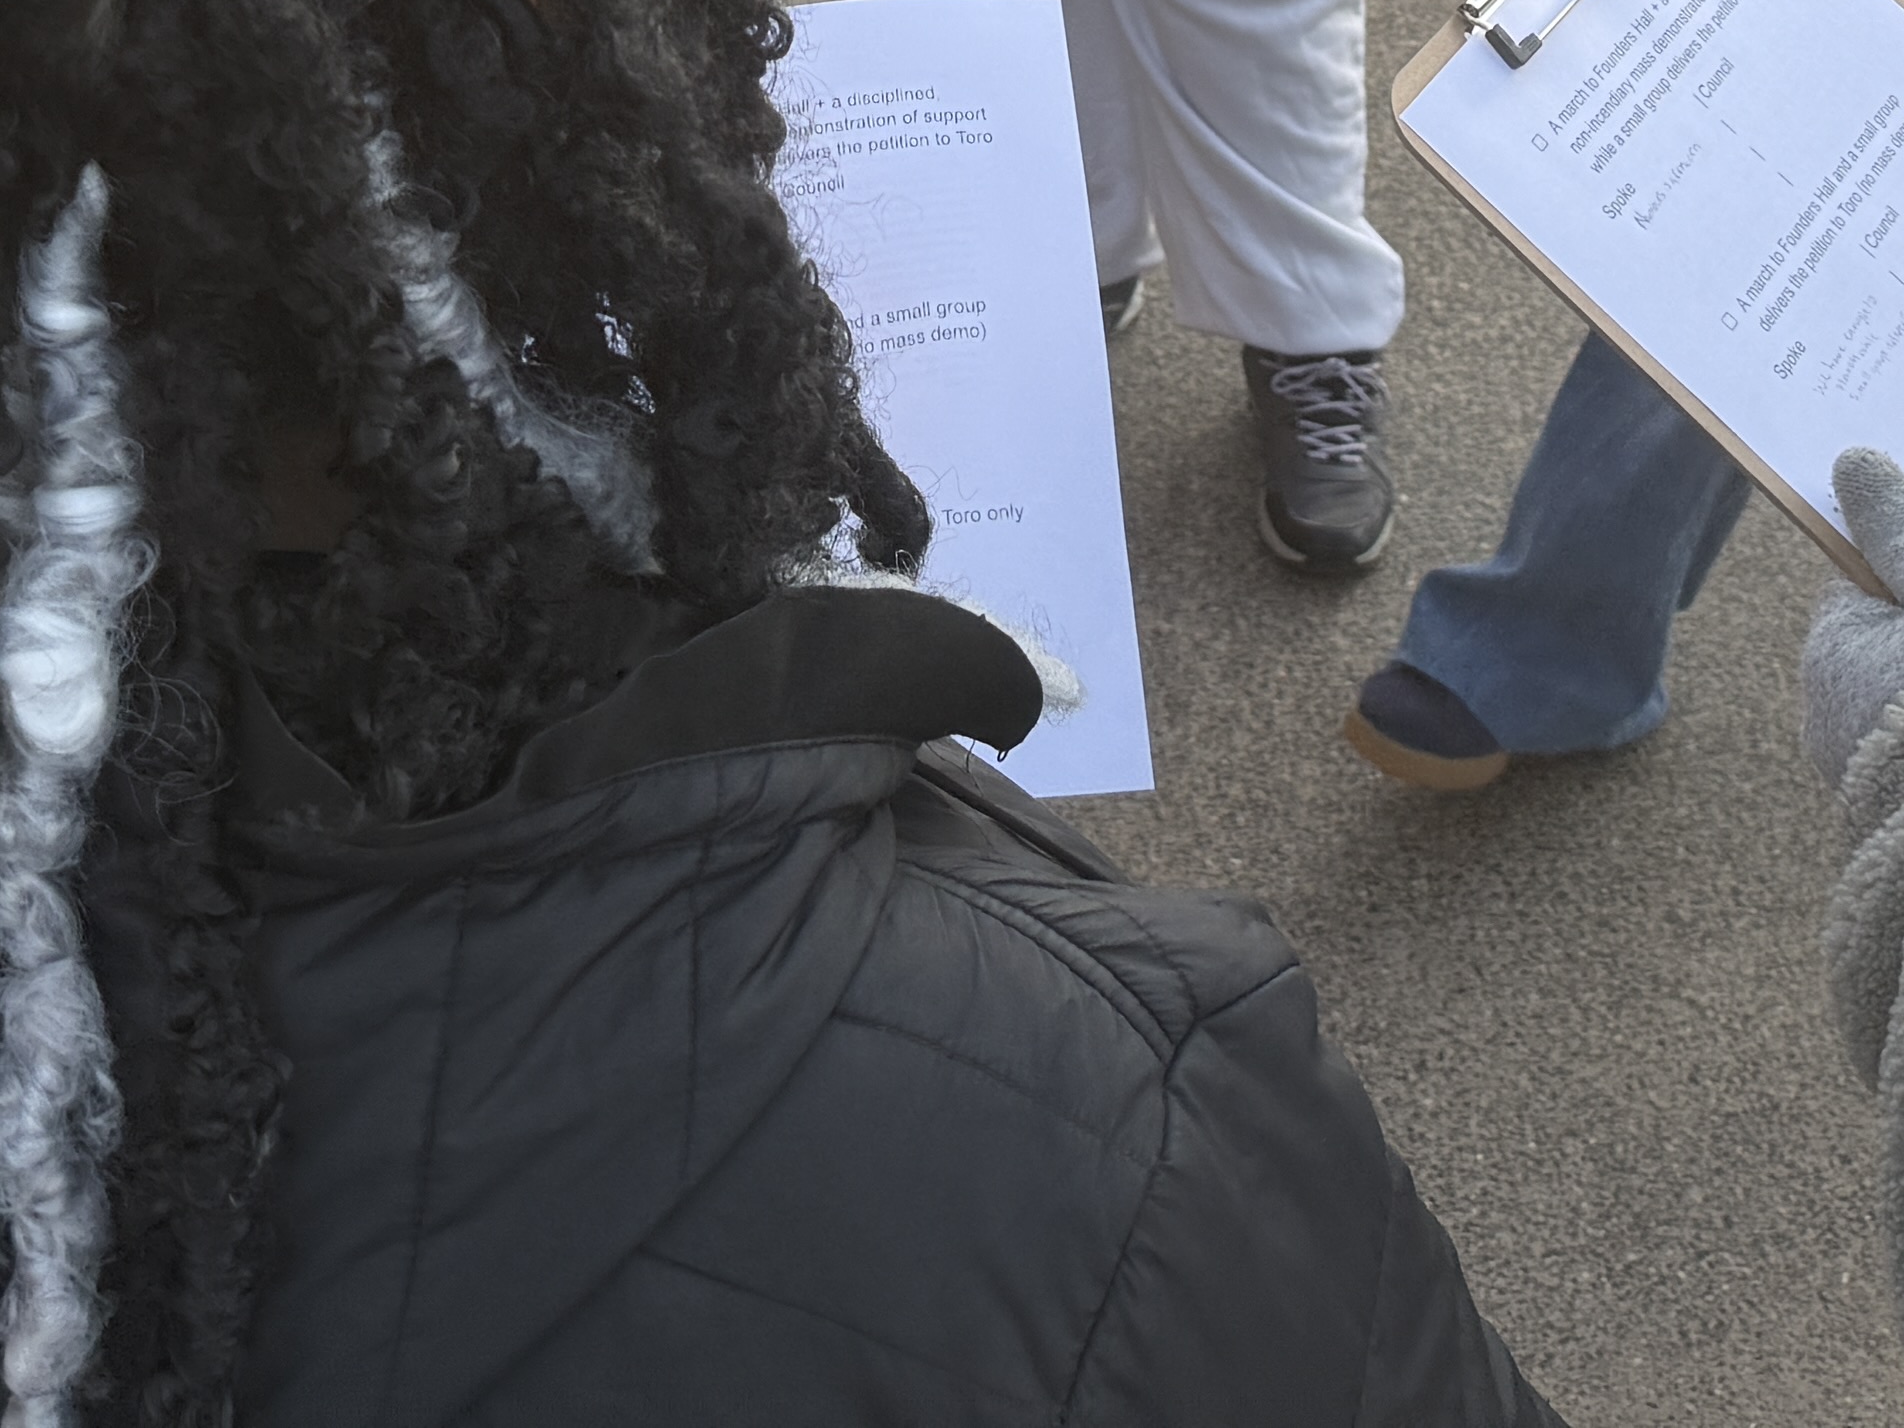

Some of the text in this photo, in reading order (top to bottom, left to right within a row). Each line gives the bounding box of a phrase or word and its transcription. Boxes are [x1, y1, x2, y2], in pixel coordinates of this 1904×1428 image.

[1557, 88, 1591, 125] march
[1592, 31, 1638, 81] Founders
[1630, 7, 1655, 36] Hall
[1697, 56, 1735, 99] Council
[831, 97, 842, 109] a
[903, 109, 918, 125] of
[924, 107, 988, 127] support
[1569, 78, 1637, 155] non-incendiary
[1629, 51, 1657, 83] mass
[1589, 143, 1618, 174] while
[1620, 103, 1648, 138] small
[1642, 77, 1672, 113] group
[1666, 39, 1703, 81] delivers
[1695, 22, 1716, 43] the
[836, 140, 863, 157] the
[868, 132, 930, 156] petition
[935, 132, 951, 146] to
[955, 130, 994, 145] Toro
[1601, 182, 1637, 220] Spoke
[1745, 263, 1777, 302] march
[1776, 201, 1822, 254] Founders
[1812, 176, 1838, 205] Hall
[1831, 156, 1853, 183] and
[1852, 119, 1880, 154] small
[1873, 94, 1900, 129] group
[1759, 286, 1796, 333] delivers
[1787, 267, 1810, 290] the
[1803, 227, 1838, 274] petition
[1836, 191, 1863, 217] Toro
[1854, 173, 1877, 197] (no
[1870, 145, 1897, 177] mass
[1864, 204, 1900, 249] Council
[848, 299, 987, 330] nd a small group
[880, 331, 926, 352] mass
[930, 322, 988, 343] demo)
[1773, 340, 1807, 380] Spoke
[941, 503, 1024, 526] Toro only
